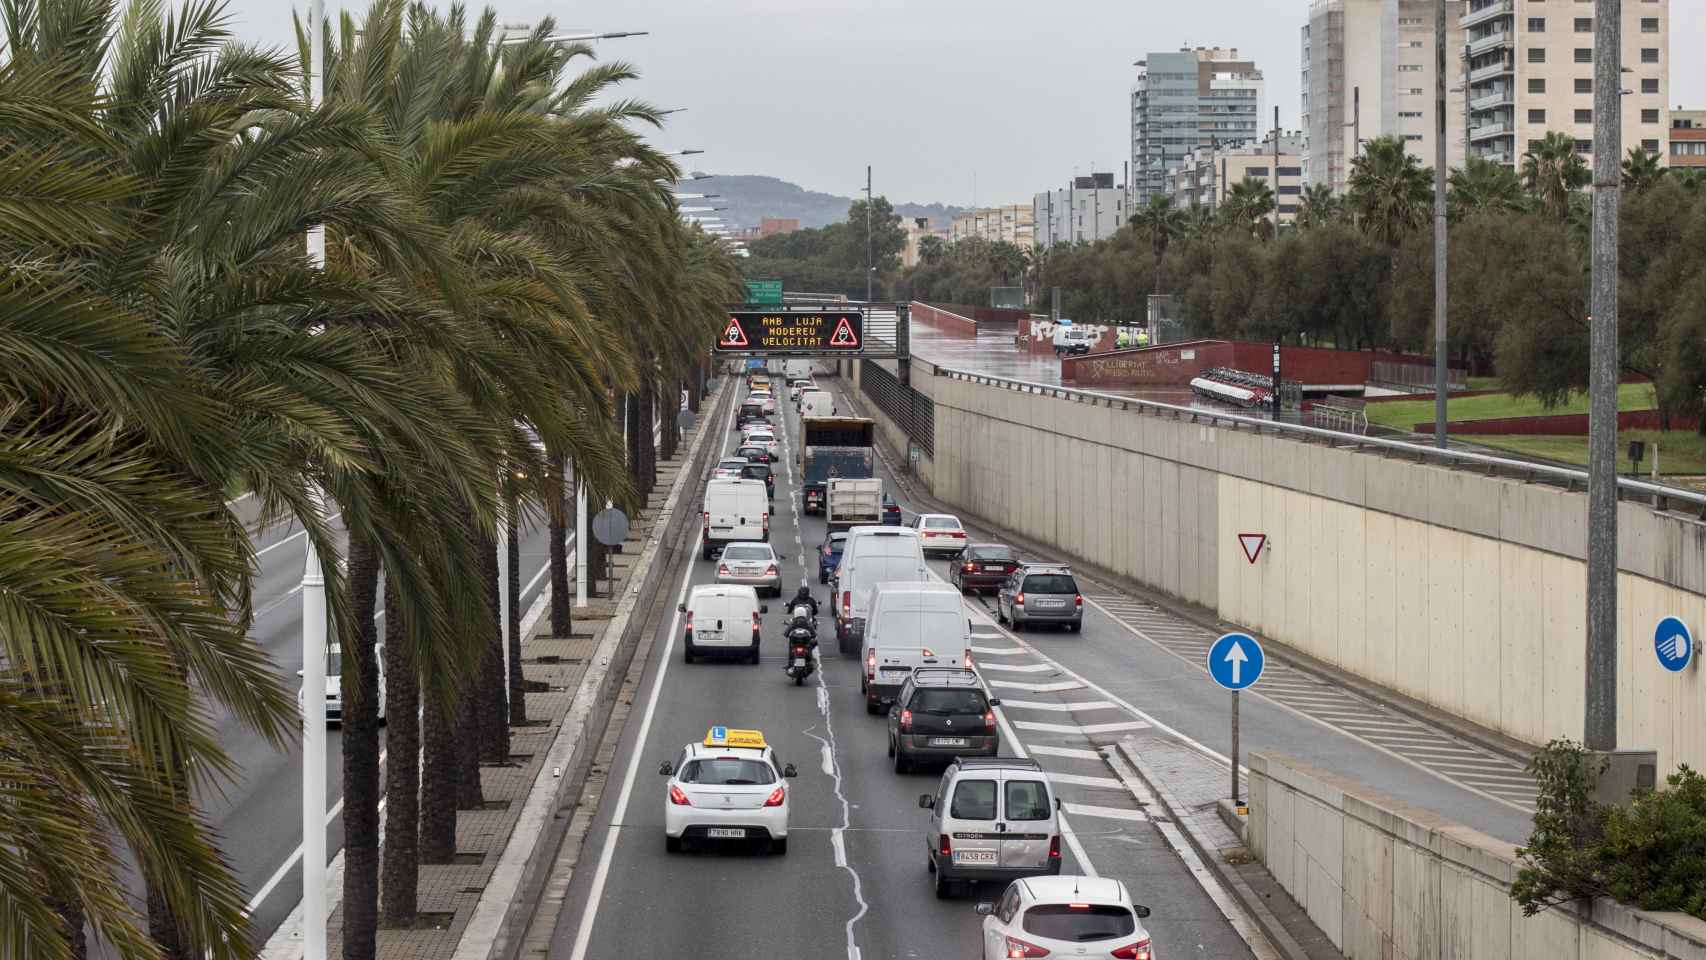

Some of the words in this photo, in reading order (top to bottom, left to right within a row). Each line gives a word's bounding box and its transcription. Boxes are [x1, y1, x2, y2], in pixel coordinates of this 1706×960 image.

[762, 317, 782, 326] AMB
[796, 317, 822, 326] LUJA
[769, 327, 815, 336] MODEREU
[762, 337, 822, 346] VELOCITAT
